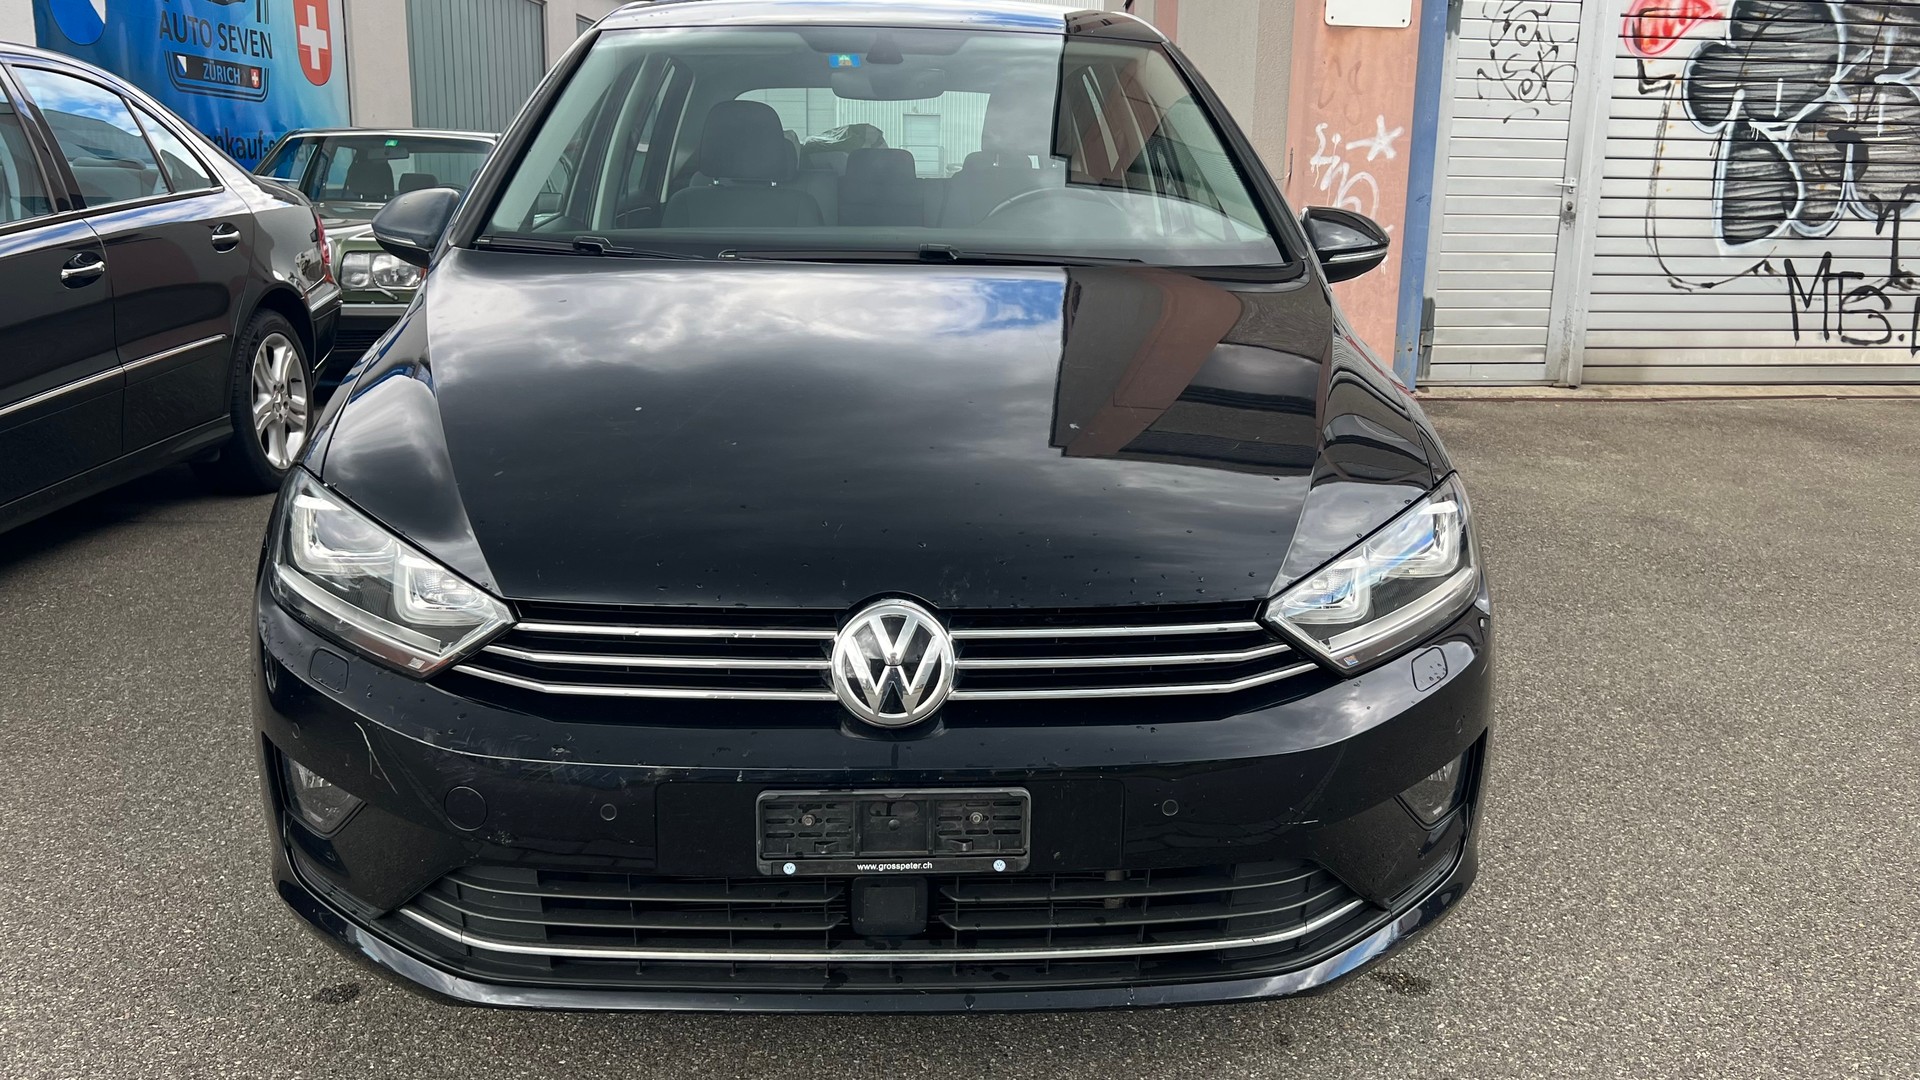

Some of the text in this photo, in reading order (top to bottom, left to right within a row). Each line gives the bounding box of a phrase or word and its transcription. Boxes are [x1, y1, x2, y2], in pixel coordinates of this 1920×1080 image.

[159, 10, 273, 59] AUTO SEVEN
[202, 60, 241, 85] ZÜRICH
[857, 861, 933, 872] www.grosspeter.ch
